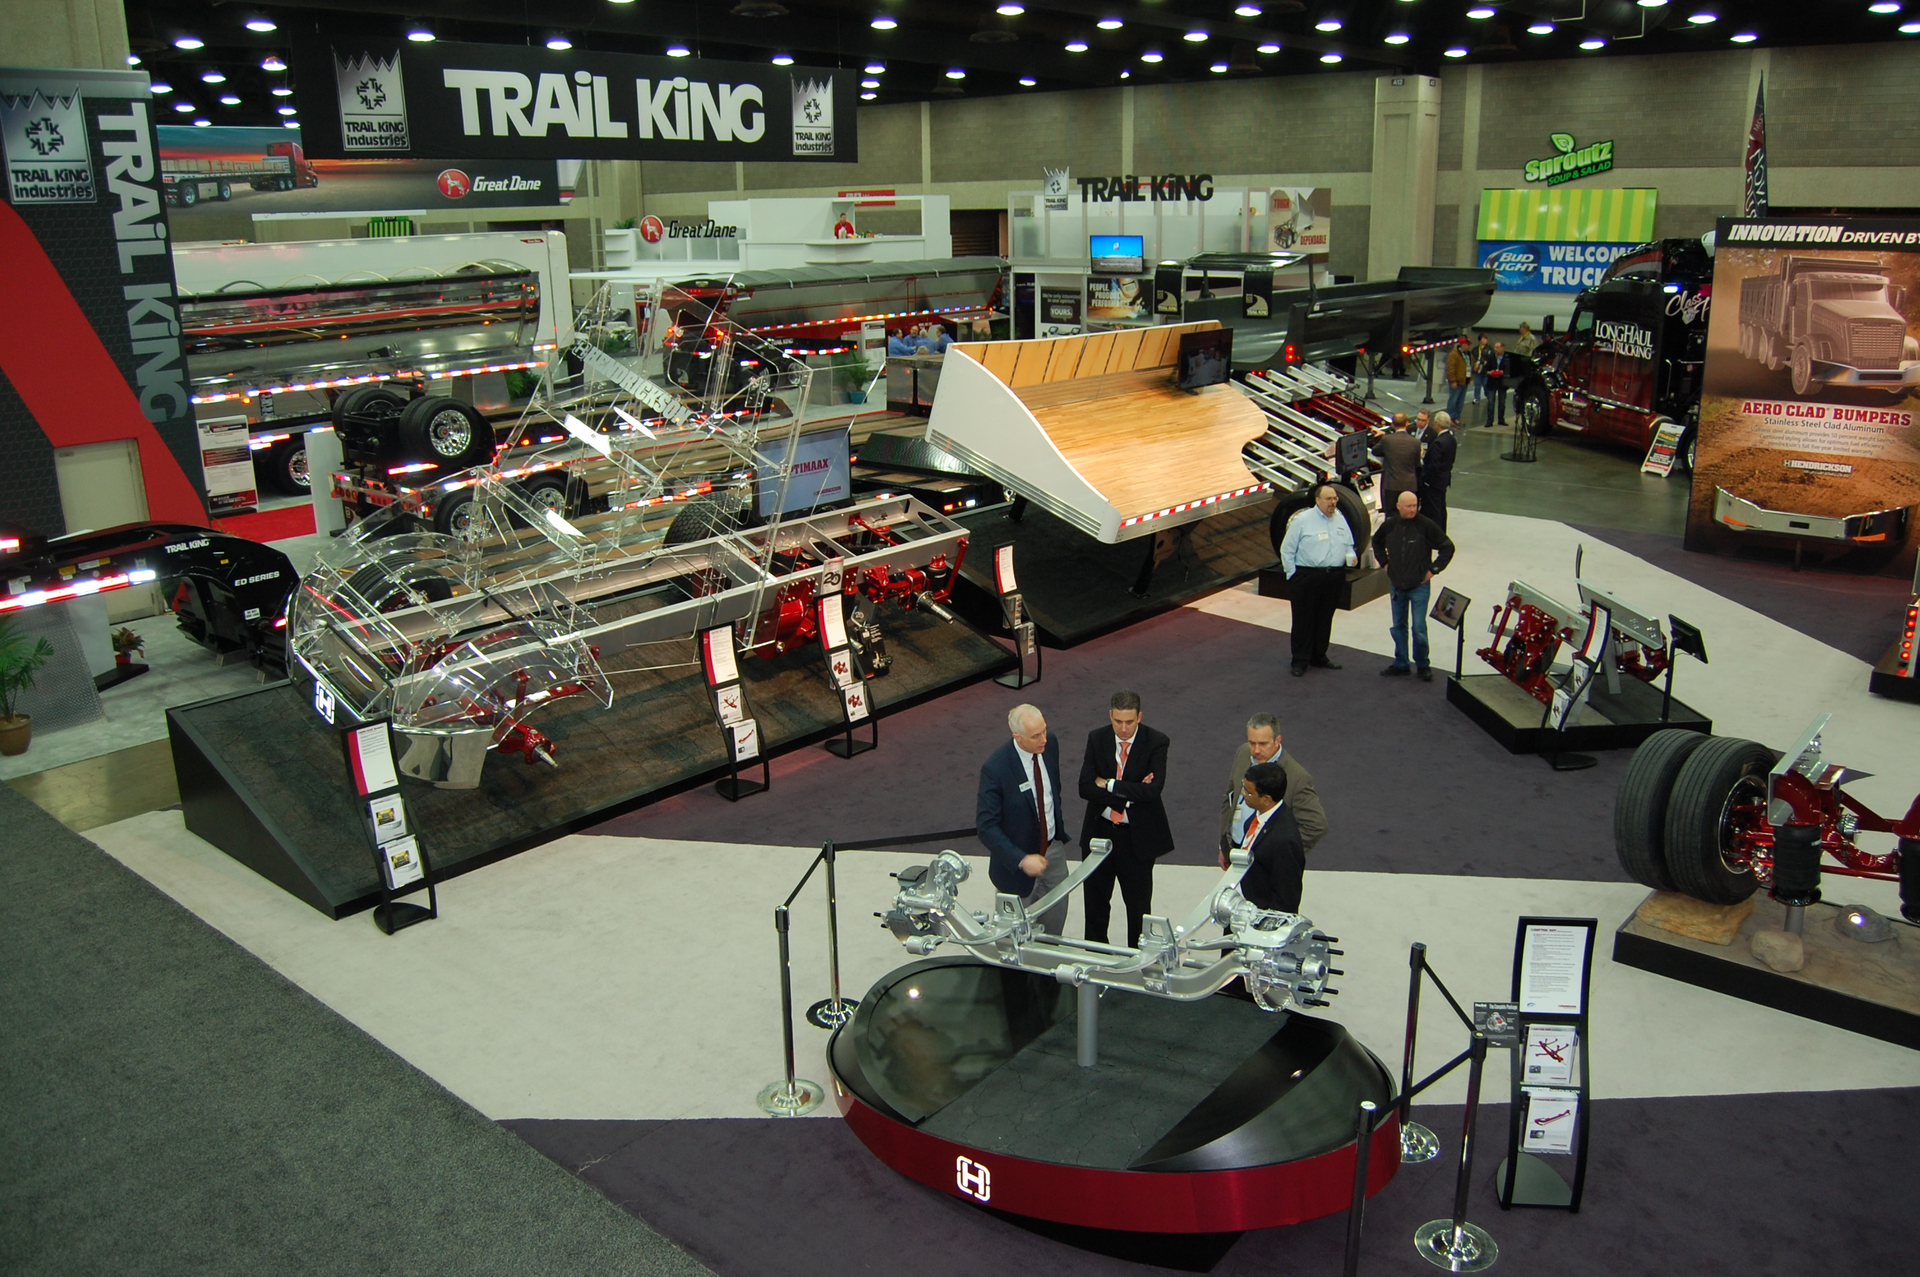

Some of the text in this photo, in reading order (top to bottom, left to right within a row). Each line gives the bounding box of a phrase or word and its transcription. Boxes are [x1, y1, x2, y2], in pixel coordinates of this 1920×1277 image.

[346, 134, 407, 146] industries
[795, 142, 832, 151] industries
[1525, 141, 1613, 181] Sproutz
[1548, 160, 1612, 186] SOUP & SALAD
[14, 184, 93, 199] industries
[472, 175, 541, 192] Great Dane
[668, 219, 737, 238] Great Dane
[1727, 224, 1844, 243] INNOVATION
[1841, 231, 1905, 244] DRIVEN
[1499, 252, 1534, 262] BUD
[1492, 261, 1538, 272] LIGHT
[1665, 290, 1702, 317] Class
[1595, 320, 1653, 348] LONGHAUL
[1611, 338, 1652, 360] TRUCKING
[584, 345, 693, 426] HENDRICKSON
[1742, 401, 1912, 427] AERO CLAD BUMPERS
[1764, 417, 1884, 434] Stainless Steel Clad Aluminum
[1785, 435, 1801, 443] styling
[1827, 438, 1849, 446] optimum
[1809, 431, 1830, 439] provides
[788, 458, 829, 475] TIMAAX
[1791, 459, 1852, 473] HENDRICKSON
[234, 570, 280, 587] ED SERIES
